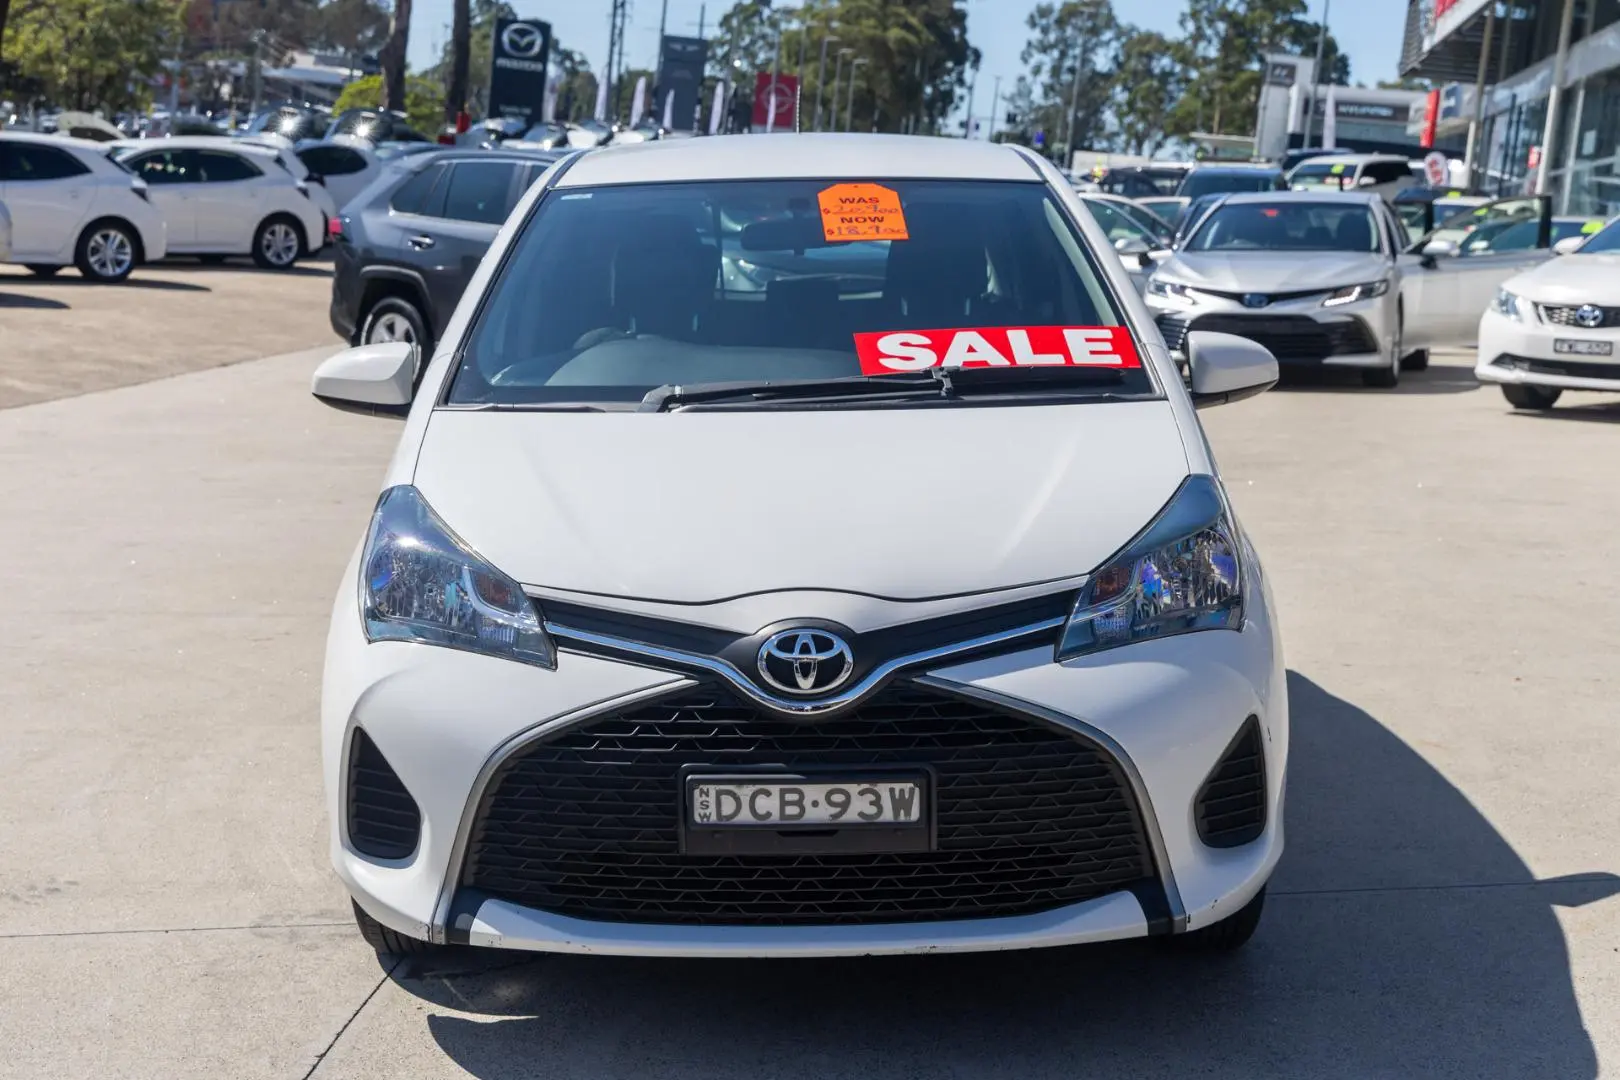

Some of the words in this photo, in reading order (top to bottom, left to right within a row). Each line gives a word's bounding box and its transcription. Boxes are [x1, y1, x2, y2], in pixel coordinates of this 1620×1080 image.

[839, 197, 880, 205] WAS
[840, 216, 885, 224] NOW
[877, 329, 1122, 370] SALE
[699, 787, 712, 823] NSW
